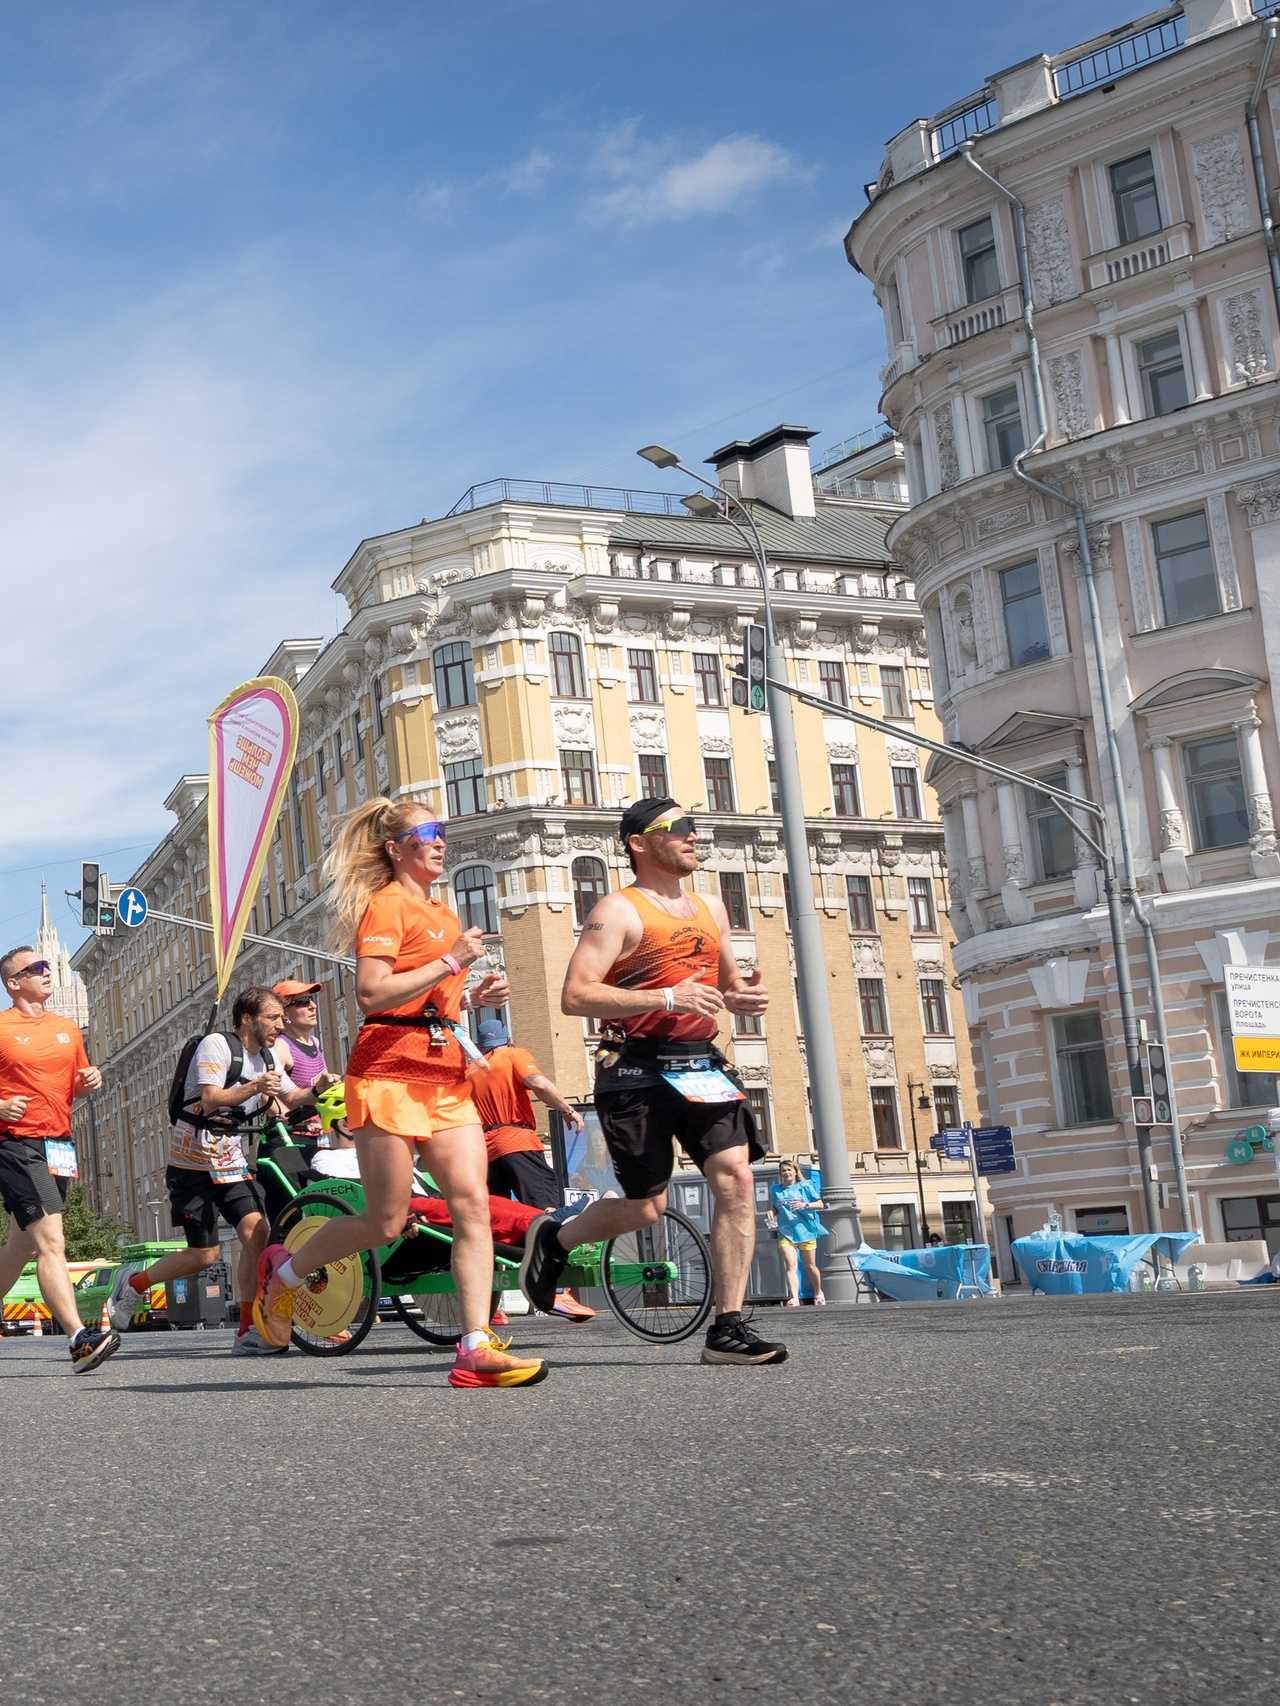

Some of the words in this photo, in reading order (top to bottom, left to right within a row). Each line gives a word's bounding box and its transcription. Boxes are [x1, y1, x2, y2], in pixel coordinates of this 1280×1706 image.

[1230, 973, 1280, 982] ПРЕЧИСТЕНКА
[1231, 983, 1251, 991] улица
[1233, 999, 1280, 1009] ПРЕЧИСТЕНС
[1235, 1010, 1263, 1019] ВОРОТА
[1236, 1021, 1267, 1029] площадь
[1240, 1050, 1251, 1058] ЖК
